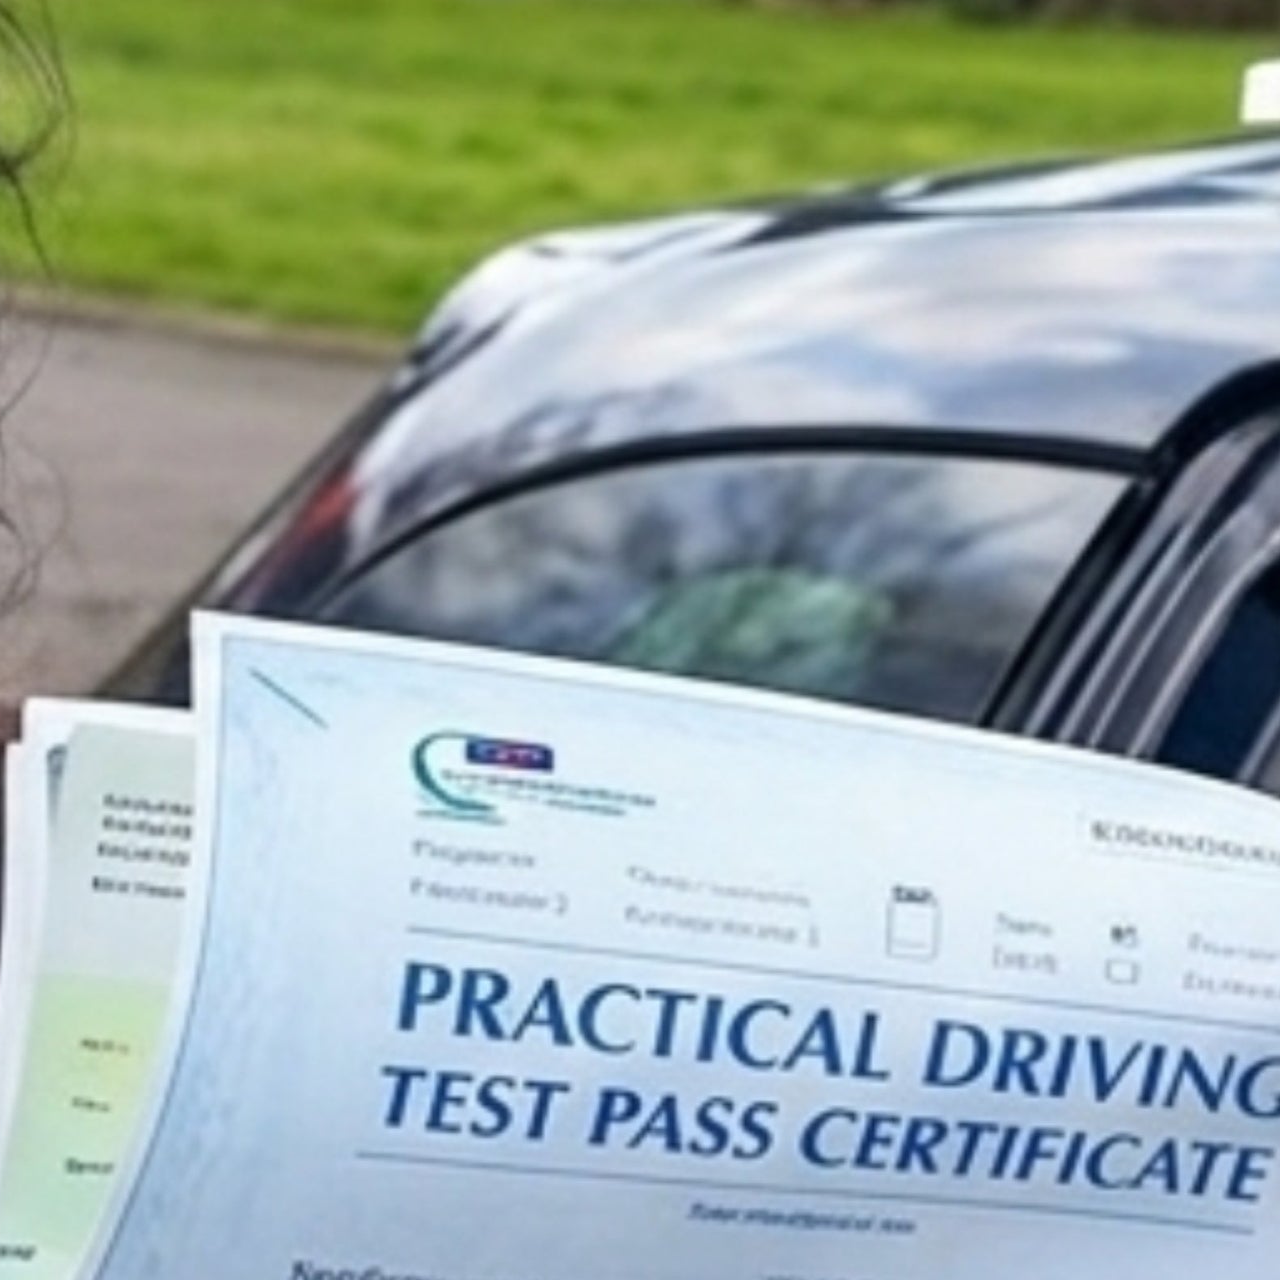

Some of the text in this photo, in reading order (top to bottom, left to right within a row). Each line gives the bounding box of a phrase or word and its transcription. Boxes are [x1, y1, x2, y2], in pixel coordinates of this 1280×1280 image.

[396, 960, 890, 1082] PRACTICAL
[379, 1065, 1276, 1203] TEST PASS CERTIFICATE
